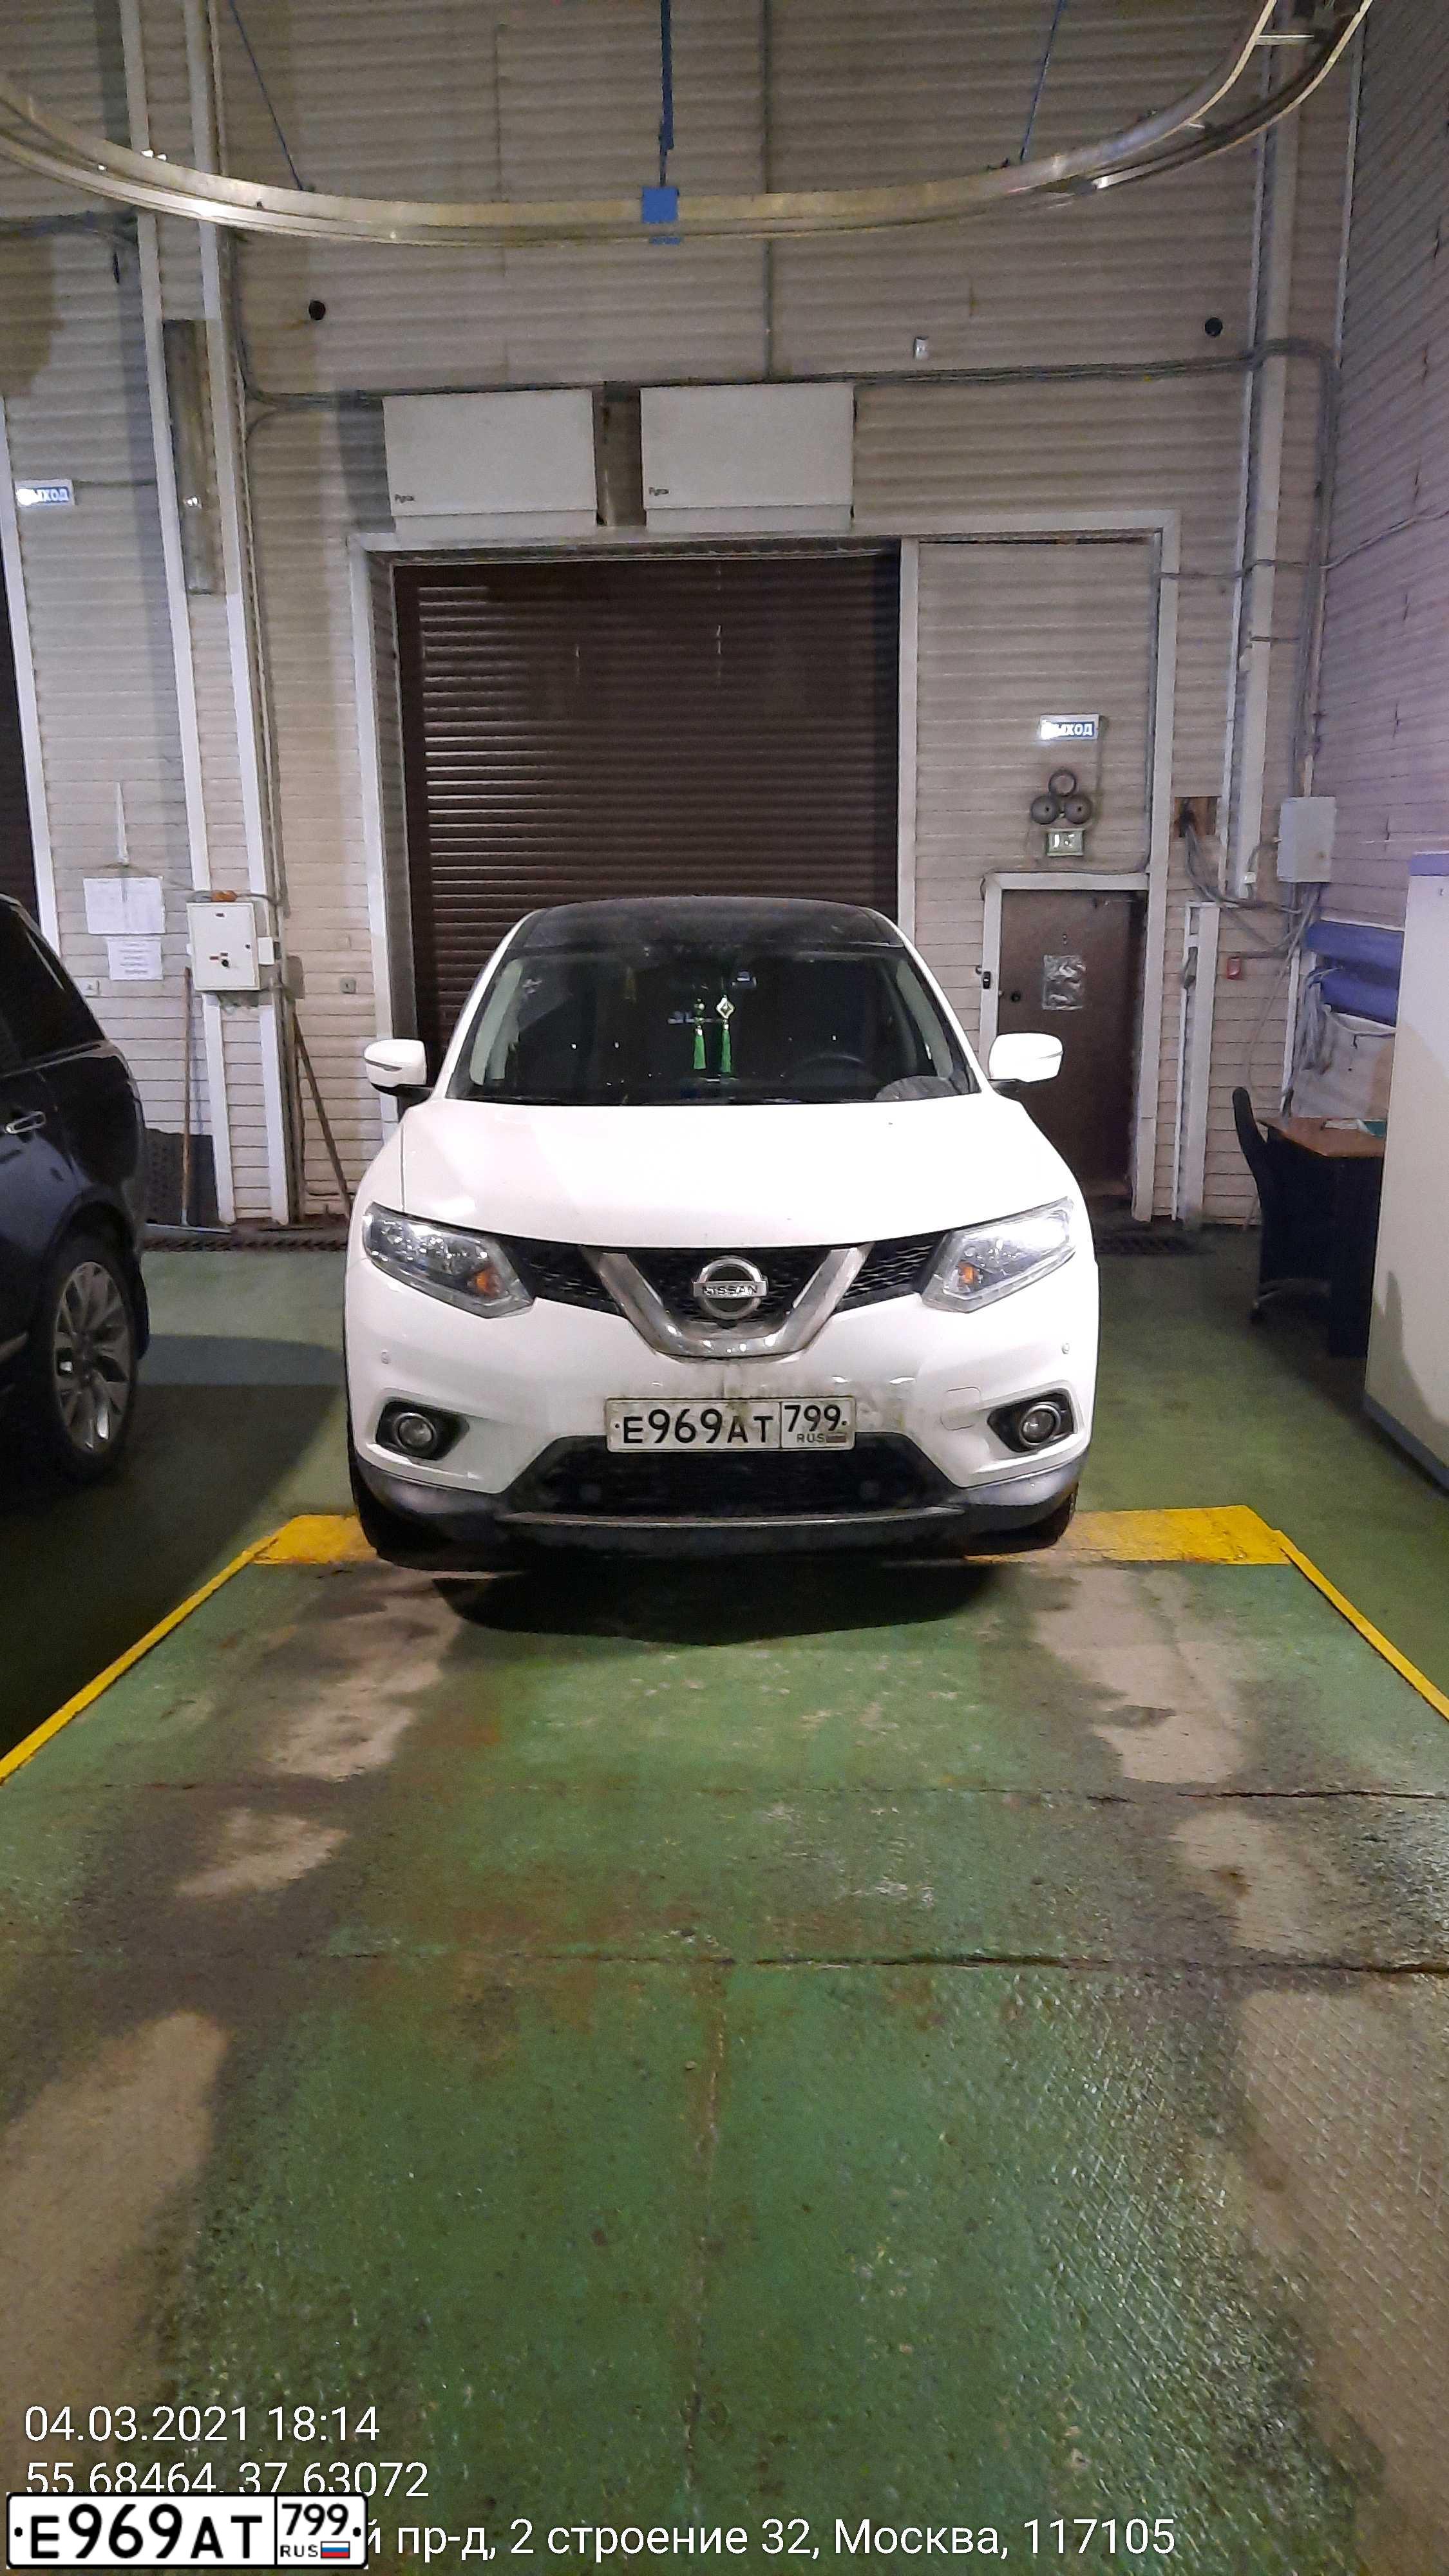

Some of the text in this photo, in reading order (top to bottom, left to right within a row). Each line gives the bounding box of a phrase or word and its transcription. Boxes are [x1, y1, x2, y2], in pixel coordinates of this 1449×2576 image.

[1042, 723, 1093, 736] ЫХОД
[784, 1405, 840, 1432] 799
[797, 1434, 825, 1443] RUS
